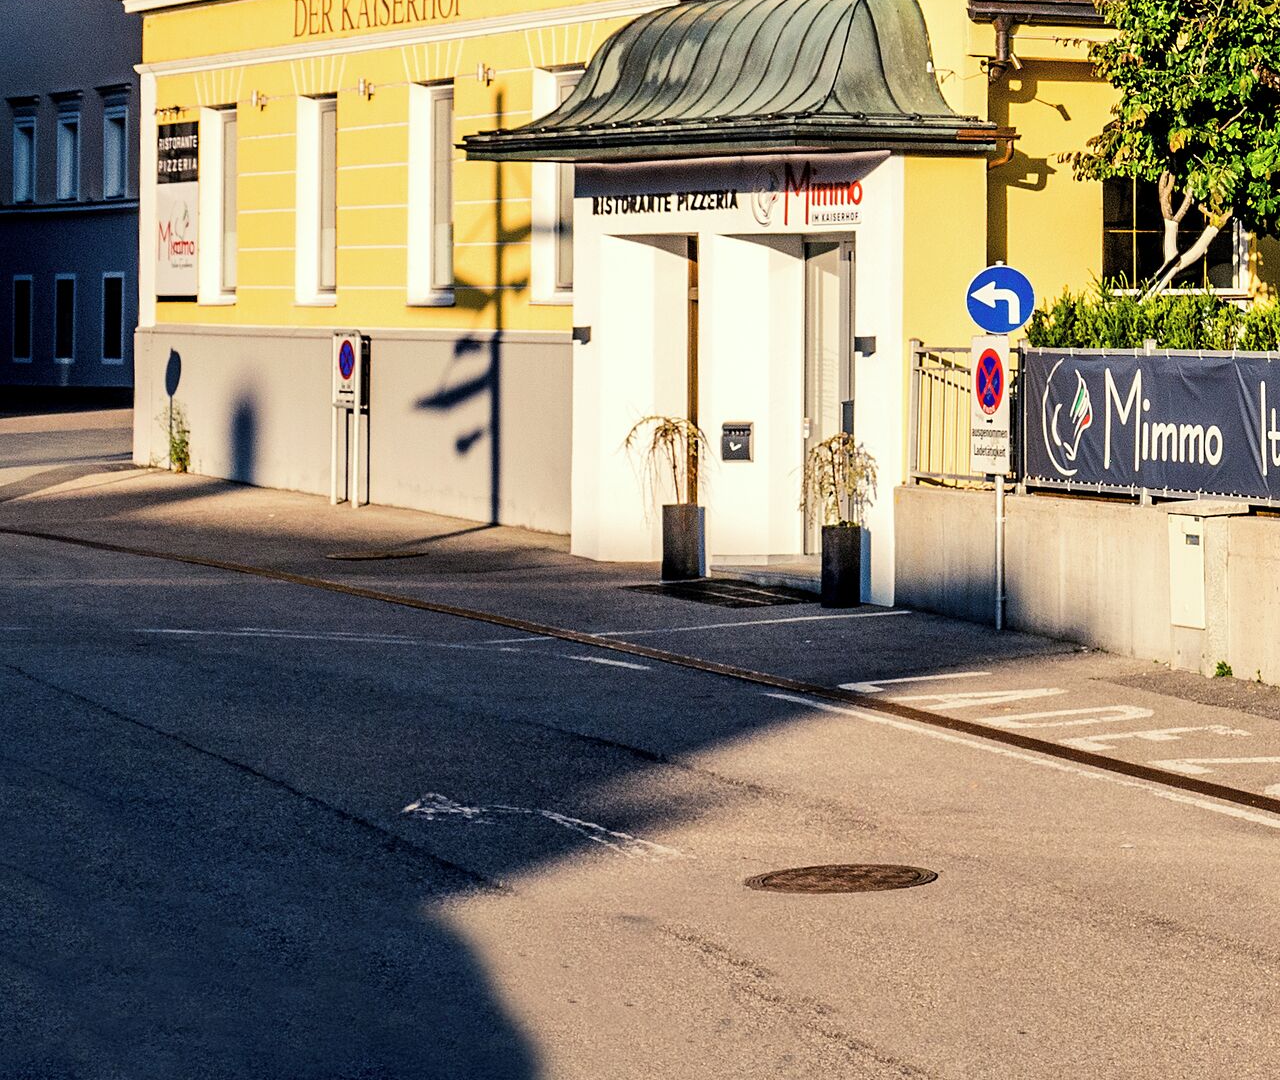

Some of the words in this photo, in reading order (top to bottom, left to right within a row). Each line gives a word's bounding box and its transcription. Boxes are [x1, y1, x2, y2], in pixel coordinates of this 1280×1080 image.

[158, 135, 198, 152] RISTORANTE
[158, 157, 198, 173] PIZZERIA
[591, 193, 672, 216] RISTORANTE
[676, 188, 739, 212] PIZZERIA
[783, 160, 864, 227] Mimmo
[811, 214, 819, 223] IM
[821, 211, 860, 223] KAISERHOF
[1104, 368, 1223, 472] Mimmo
[971, 428, 1008, 440] ausgenommen
